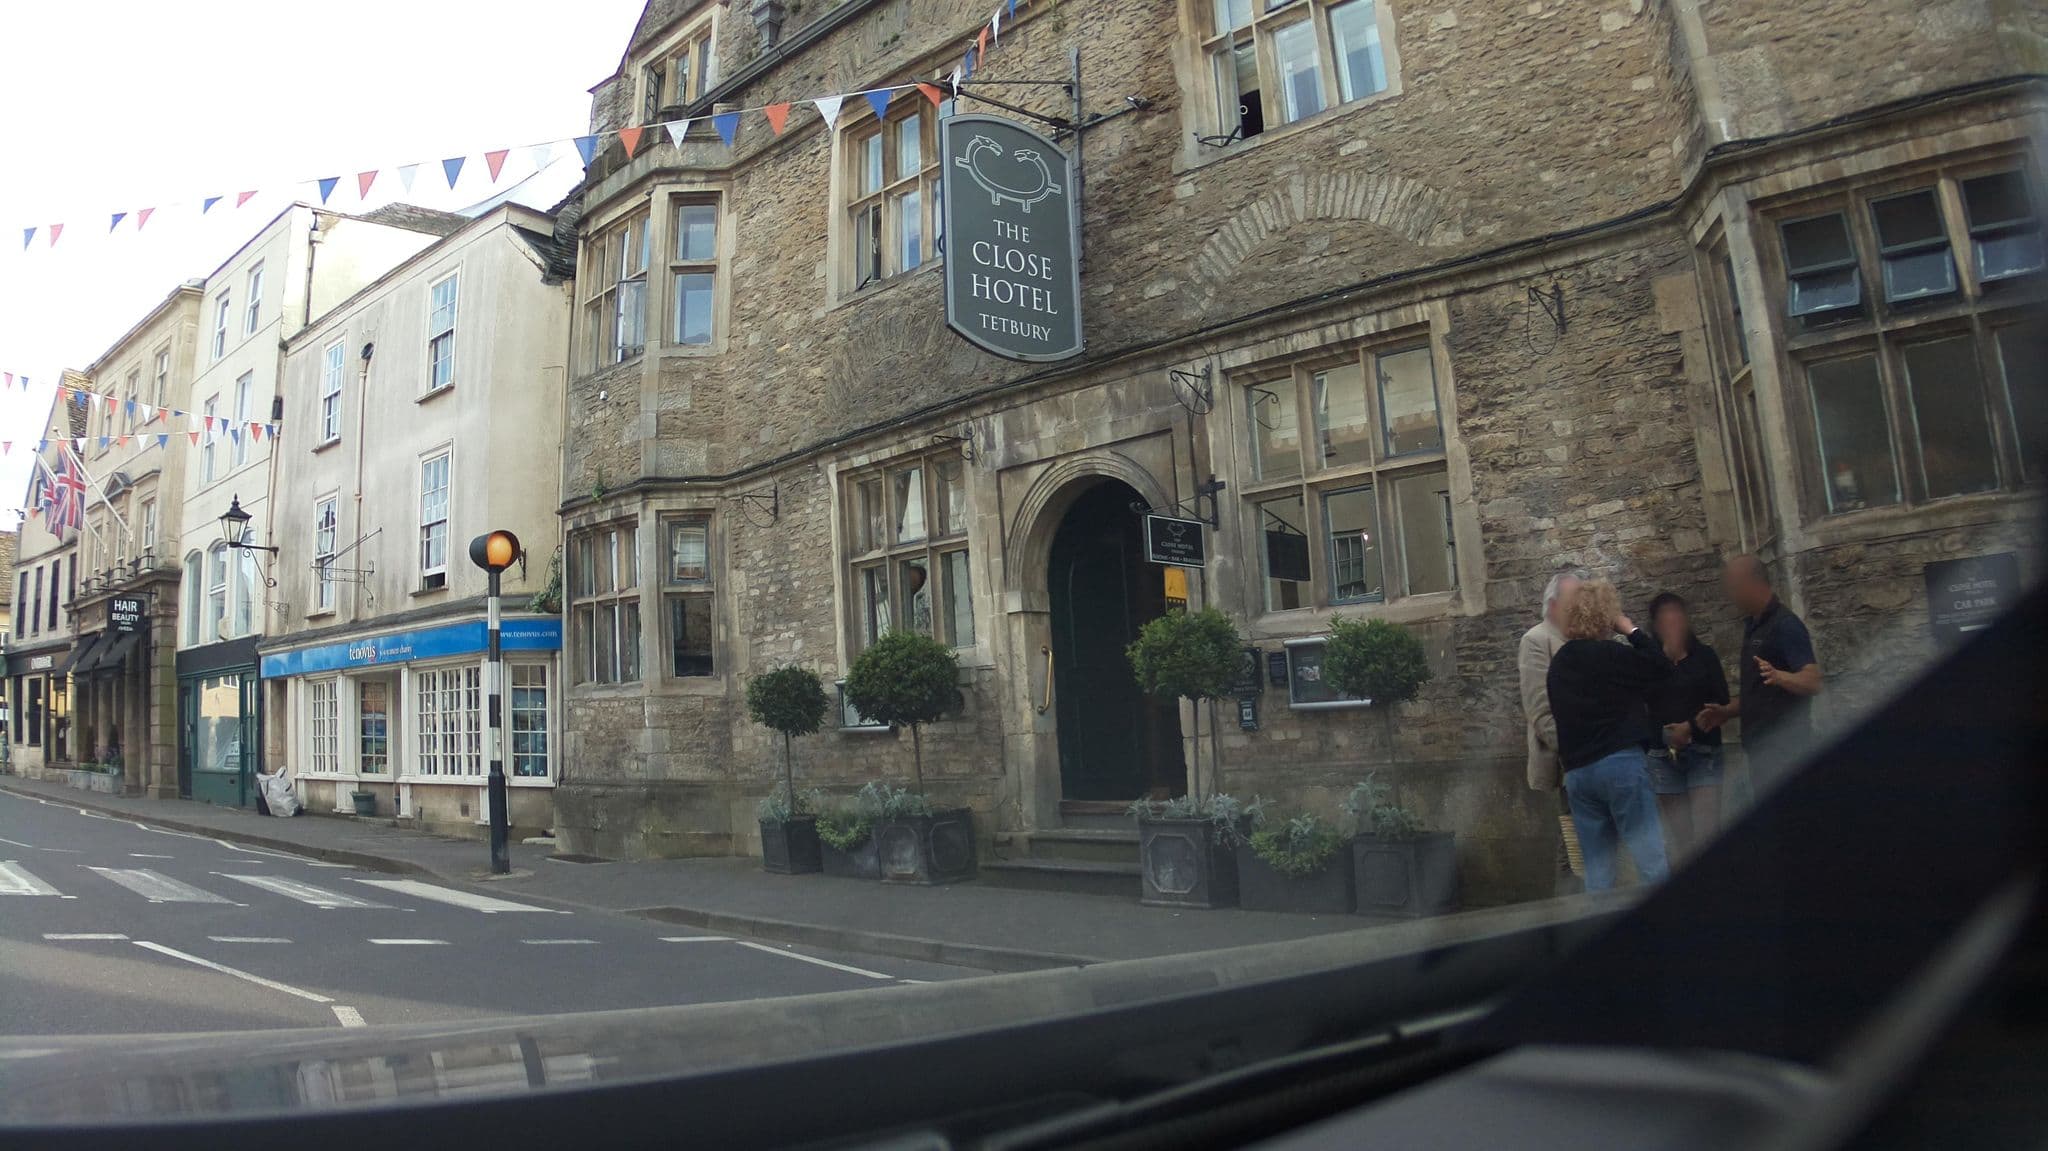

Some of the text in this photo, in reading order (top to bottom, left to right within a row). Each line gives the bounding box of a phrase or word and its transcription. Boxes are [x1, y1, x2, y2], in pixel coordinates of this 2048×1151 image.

[993, 219, 1030, 243] THE
[972, 241, 1053, 280] CLOSE
[971, 273, 1058, 315] HOTEL
[979, 313, 1051, 341] TETBURY
[111, 612, 140, 622] BEAUTY
[114, 599, 137, 612] HAIR
[349, 644, 376, 661] tenovus
